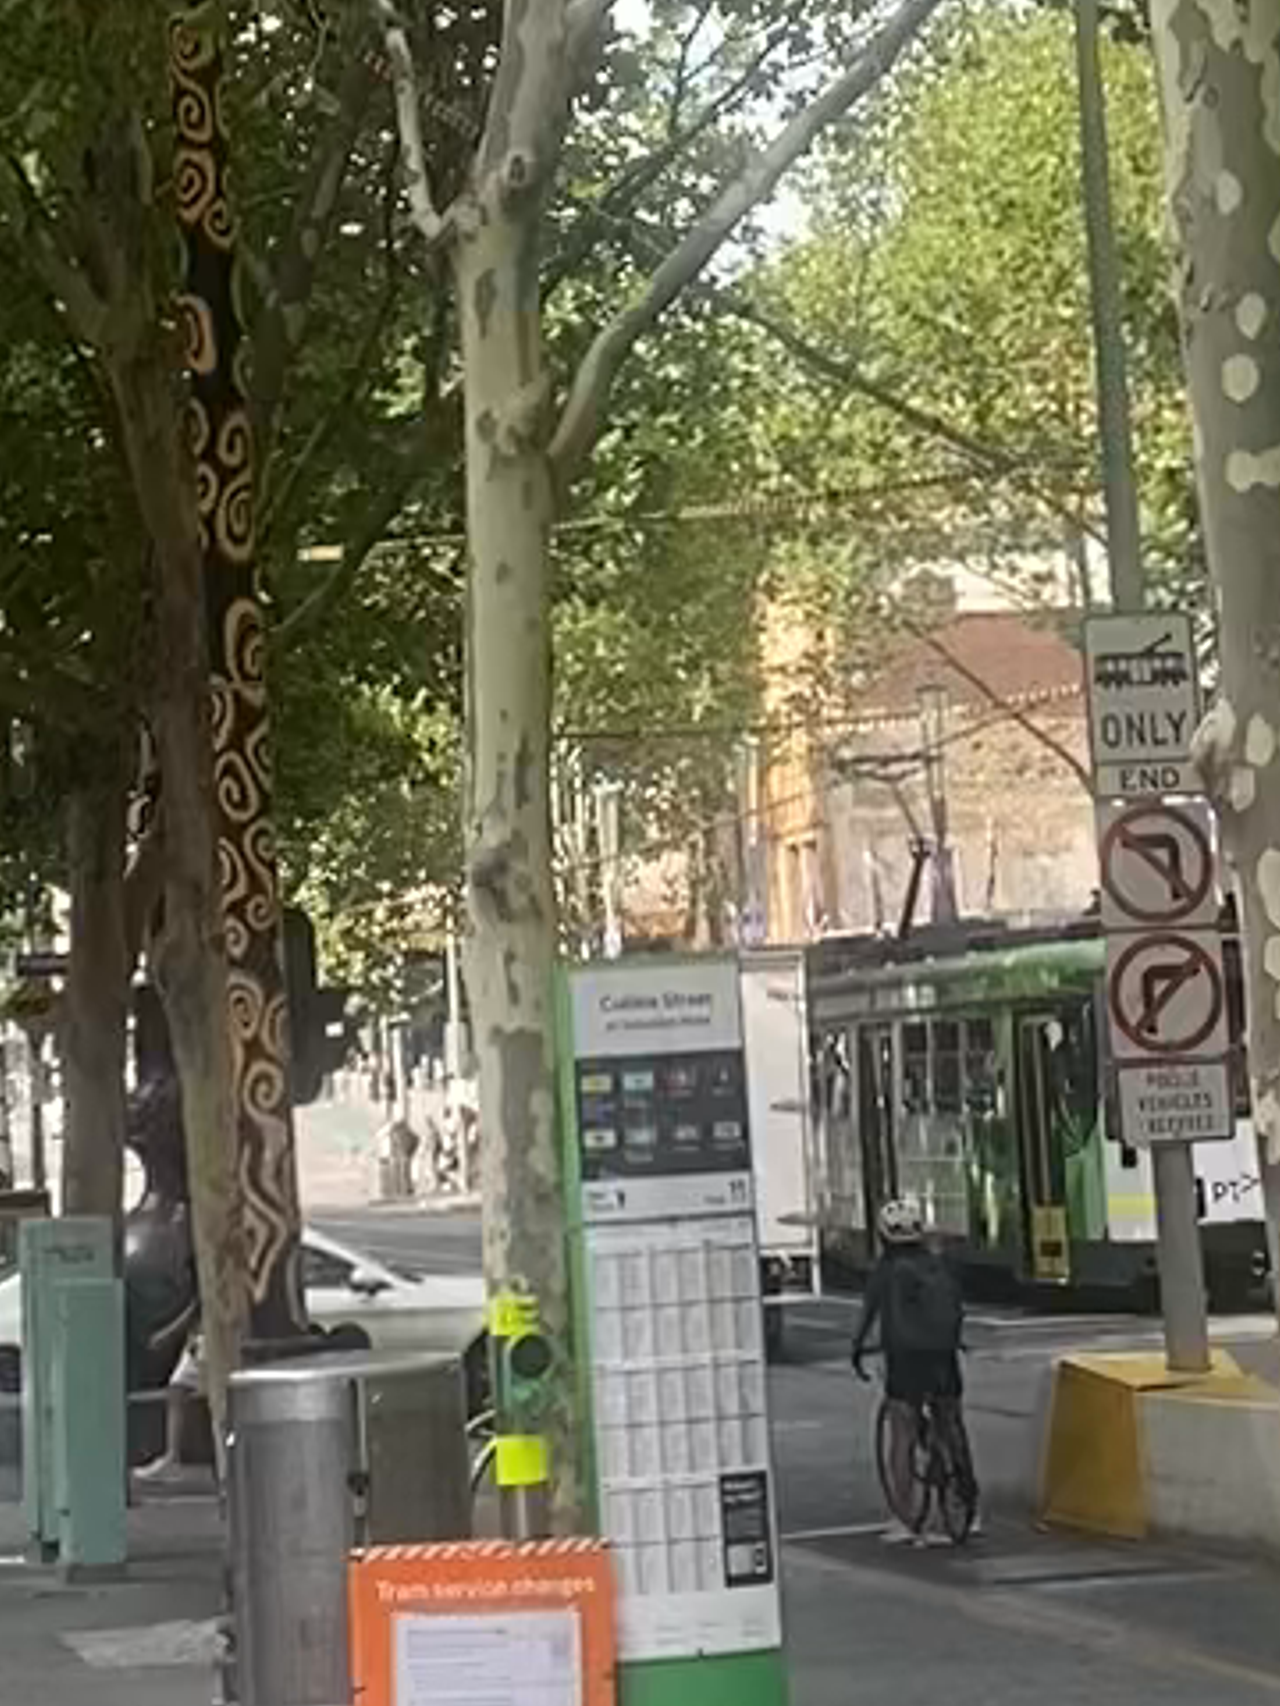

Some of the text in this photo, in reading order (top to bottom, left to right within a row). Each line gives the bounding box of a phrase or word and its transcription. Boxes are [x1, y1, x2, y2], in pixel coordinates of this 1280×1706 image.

[1101, 710, 1187, 749] ONLY
[1120, 767, 1180, 791] END
[663, 992, 712, 1009] Street
[1138, 1093, 1212, 1112] VEHICLES
[375, 1577, 596, 1603] Tram service changes
